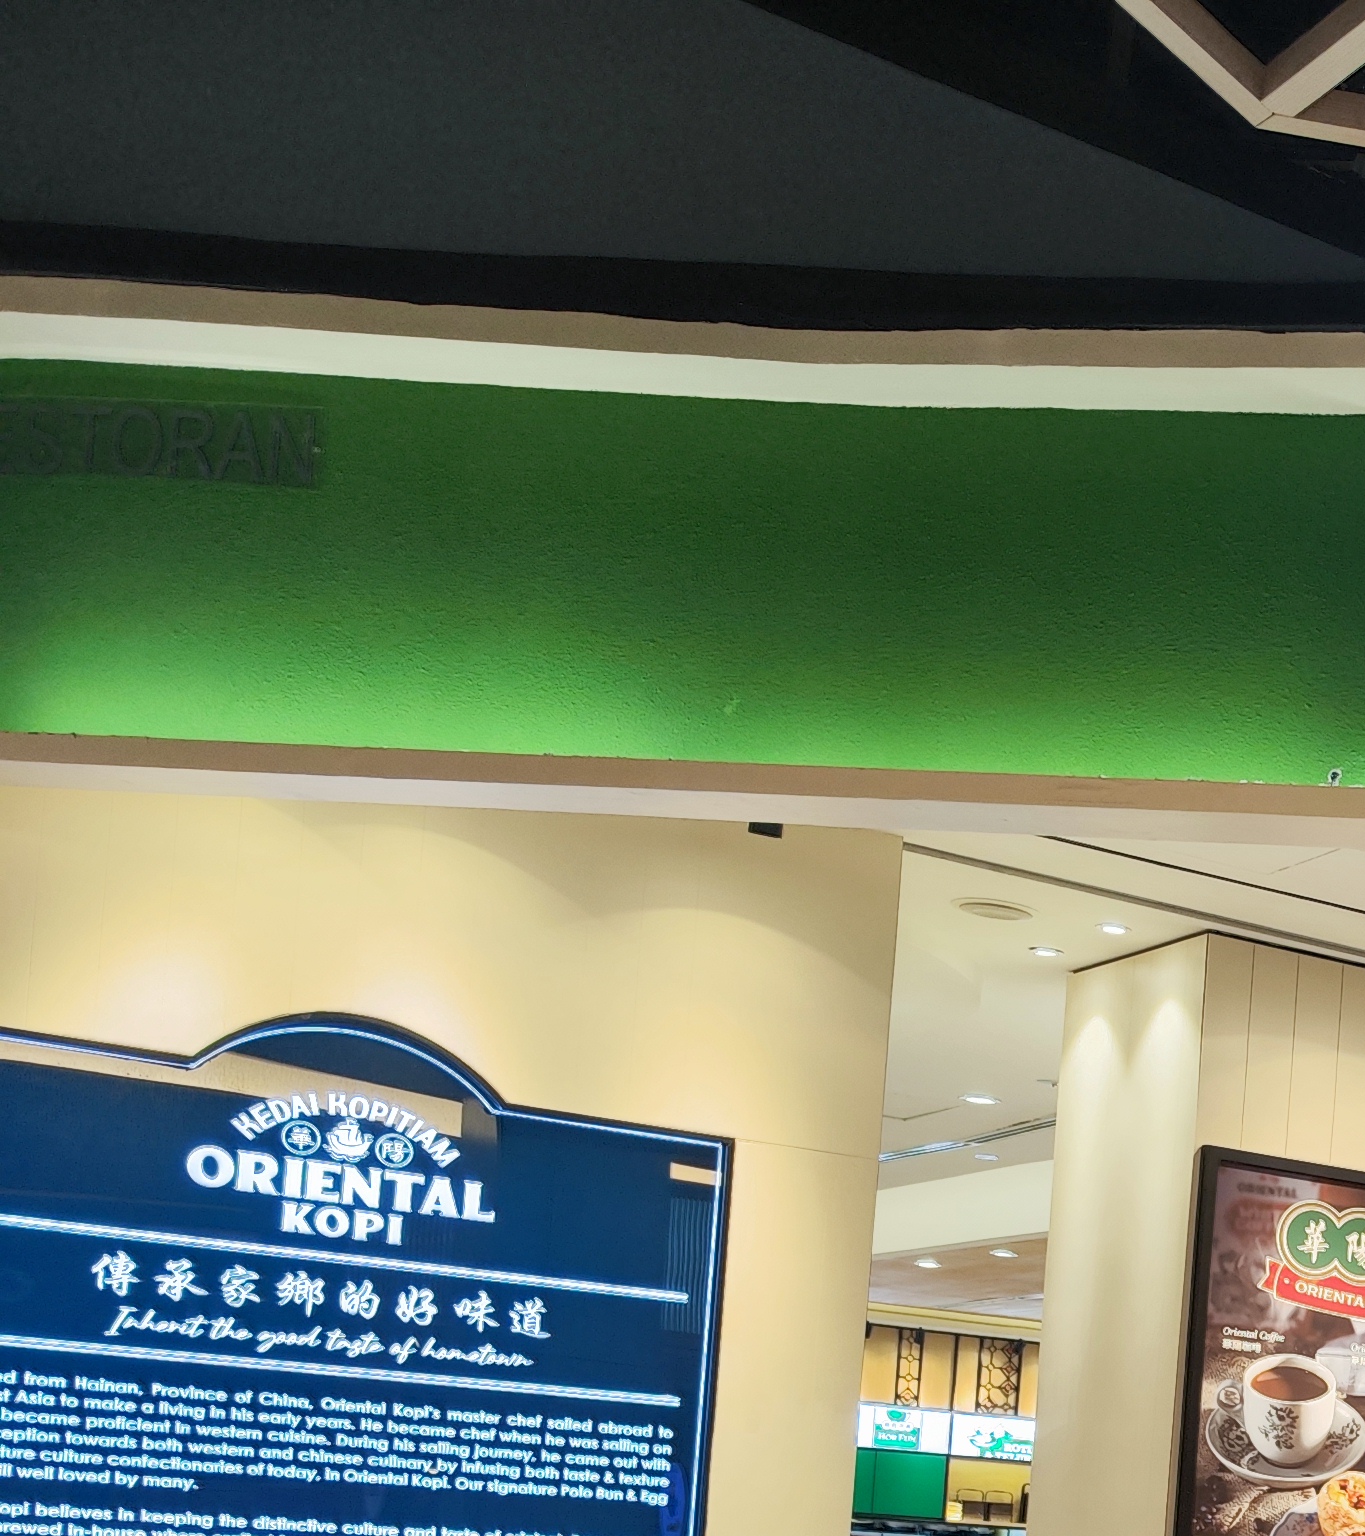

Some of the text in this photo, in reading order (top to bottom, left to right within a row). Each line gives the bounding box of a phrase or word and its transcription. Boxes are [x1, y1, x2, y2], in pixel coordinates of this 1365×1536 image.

[230, 1091, 461, 1168] KEDAI KOPITIAM
[185, 1145, 496, 1224] ORIENTAL
[280, 1201, 403, 1246] KOPI
[104, 1306, 535, 1368] Inherit the good taste of hometown
[1222, 1326, 1286, 1344] Oriental Coffee
[23, 1371, 67, 1388] from
[151, 1381, 228, 1401] Province
[234, 1389, 254, 1403] of
[320, 1395, 387, 1414] Oriental
[446, 1409, 502, 1424] master
[506, 1411, 543, 1427] chef
[546, 1416, 593, 1432] sailed
[597, 1420, 654, 1437] abroad
[657, 1423, 674, 1438] to
[0, 1406, 81, 1425] became
[85, 1414, 172, 1432] proficient
[174, 1419, 191, 1434] in
[195, 1424, 263, 1440] western
[335, 1432, 390, 1453] During
[392, 1435, 416, 1451] his
[418, 1439, 471, 1460] sailing
[541, 1447, 562, 1462] he
[564, 1453, 611, 1466] came
[612, 1454, 639, 1468] out
[640, 1455, 671, 1471] with
[39, 1447, 104, 1464] culture
[106, 1453, 244, 1474] confectionaries
[246, 1461, 266, 1475] of
[324, 1466, 341, 1480] in
[342, 1467, 409, 1485] Oriental
[454, 1475, 486, 1490] Our
[486, 1477, 559, 1496] signature
[560, 1482, 594, 1498] Polo
[595, 1484, 624, 1500] Bun
[625, 1486, 638, 1501] &
[639, 1488, 669, 1508] Egg
[34, 1502, 113, 1520] believes
[117, 1506, 135, 1521] in
[139, 1508, 214, 1529] keeping
[218, 1513, 248, 1528] the
[252, 1514, 338, 1533] distinctive
[341, 1520, 400, 1536] culture
